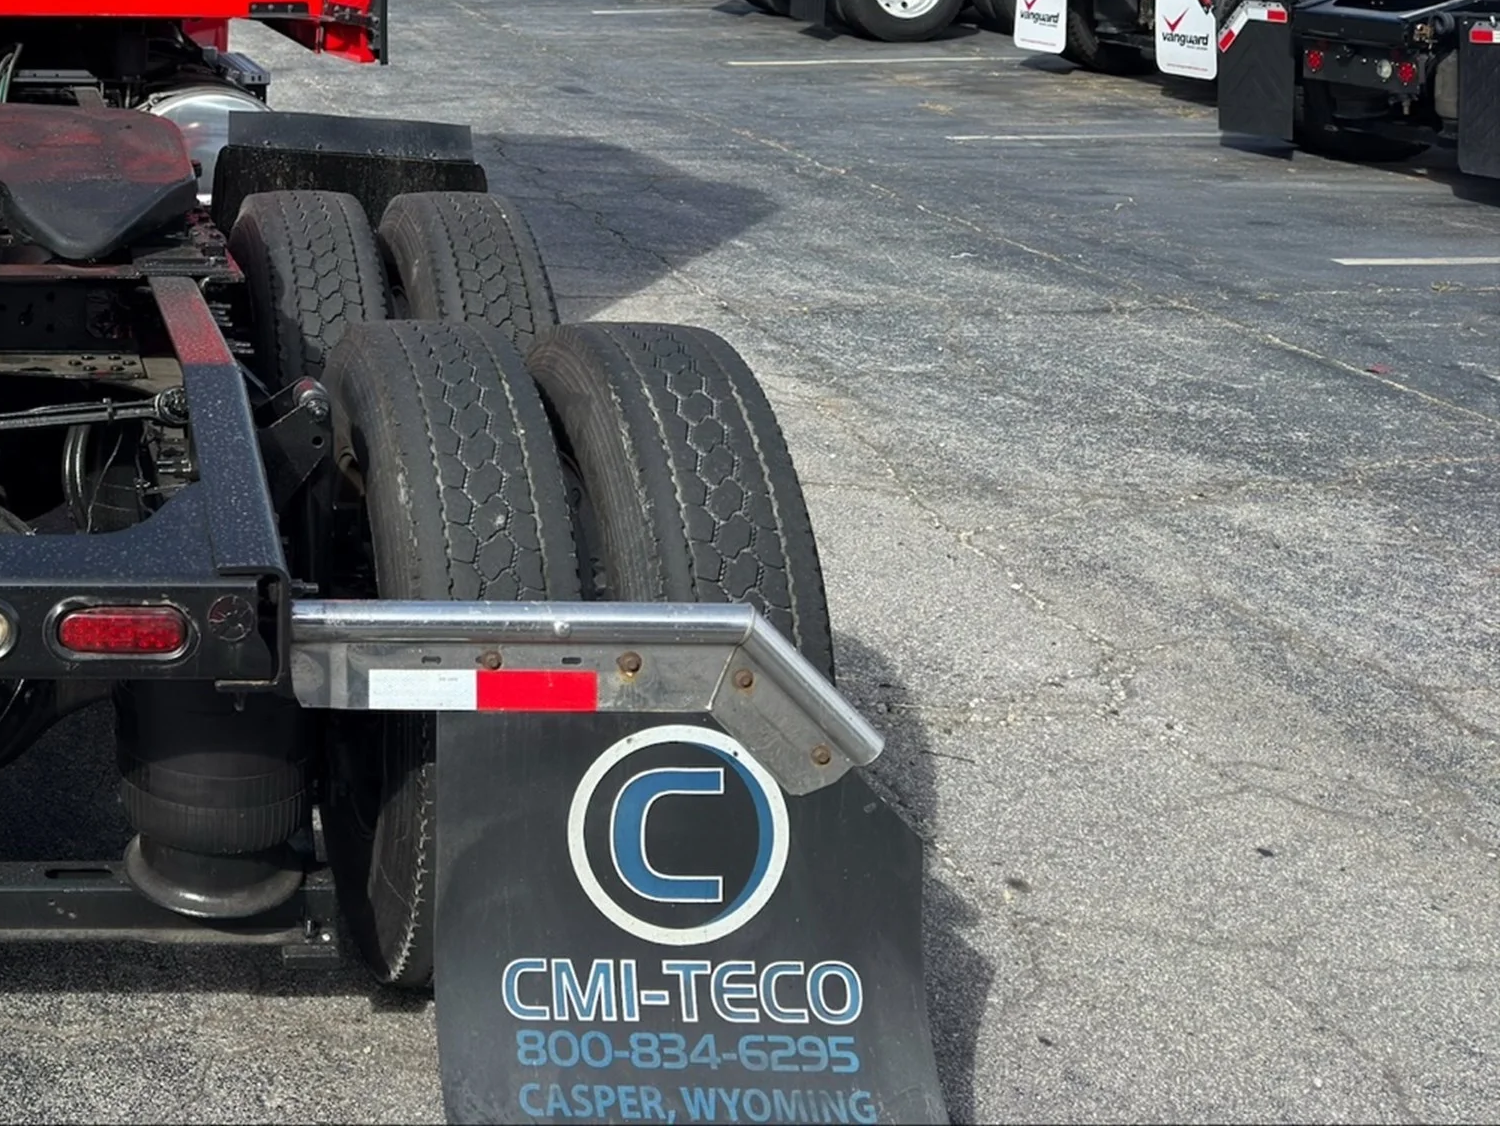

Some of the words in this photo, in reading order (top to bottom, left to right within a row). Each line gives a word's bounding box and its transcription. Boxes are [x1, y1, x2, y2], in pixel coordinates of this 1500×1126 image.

[1020, 10, 1060, 24] vanguard
[1161, 32, 1210, 46] vanguard
[502, 958, 863, 1025] CMI-TECO
[515, 1029, 861, 1073] 800-834-6295
[518, 1082, 677, 1125] CASPER,
[680, 1087, 879, 1125] WYOMING
